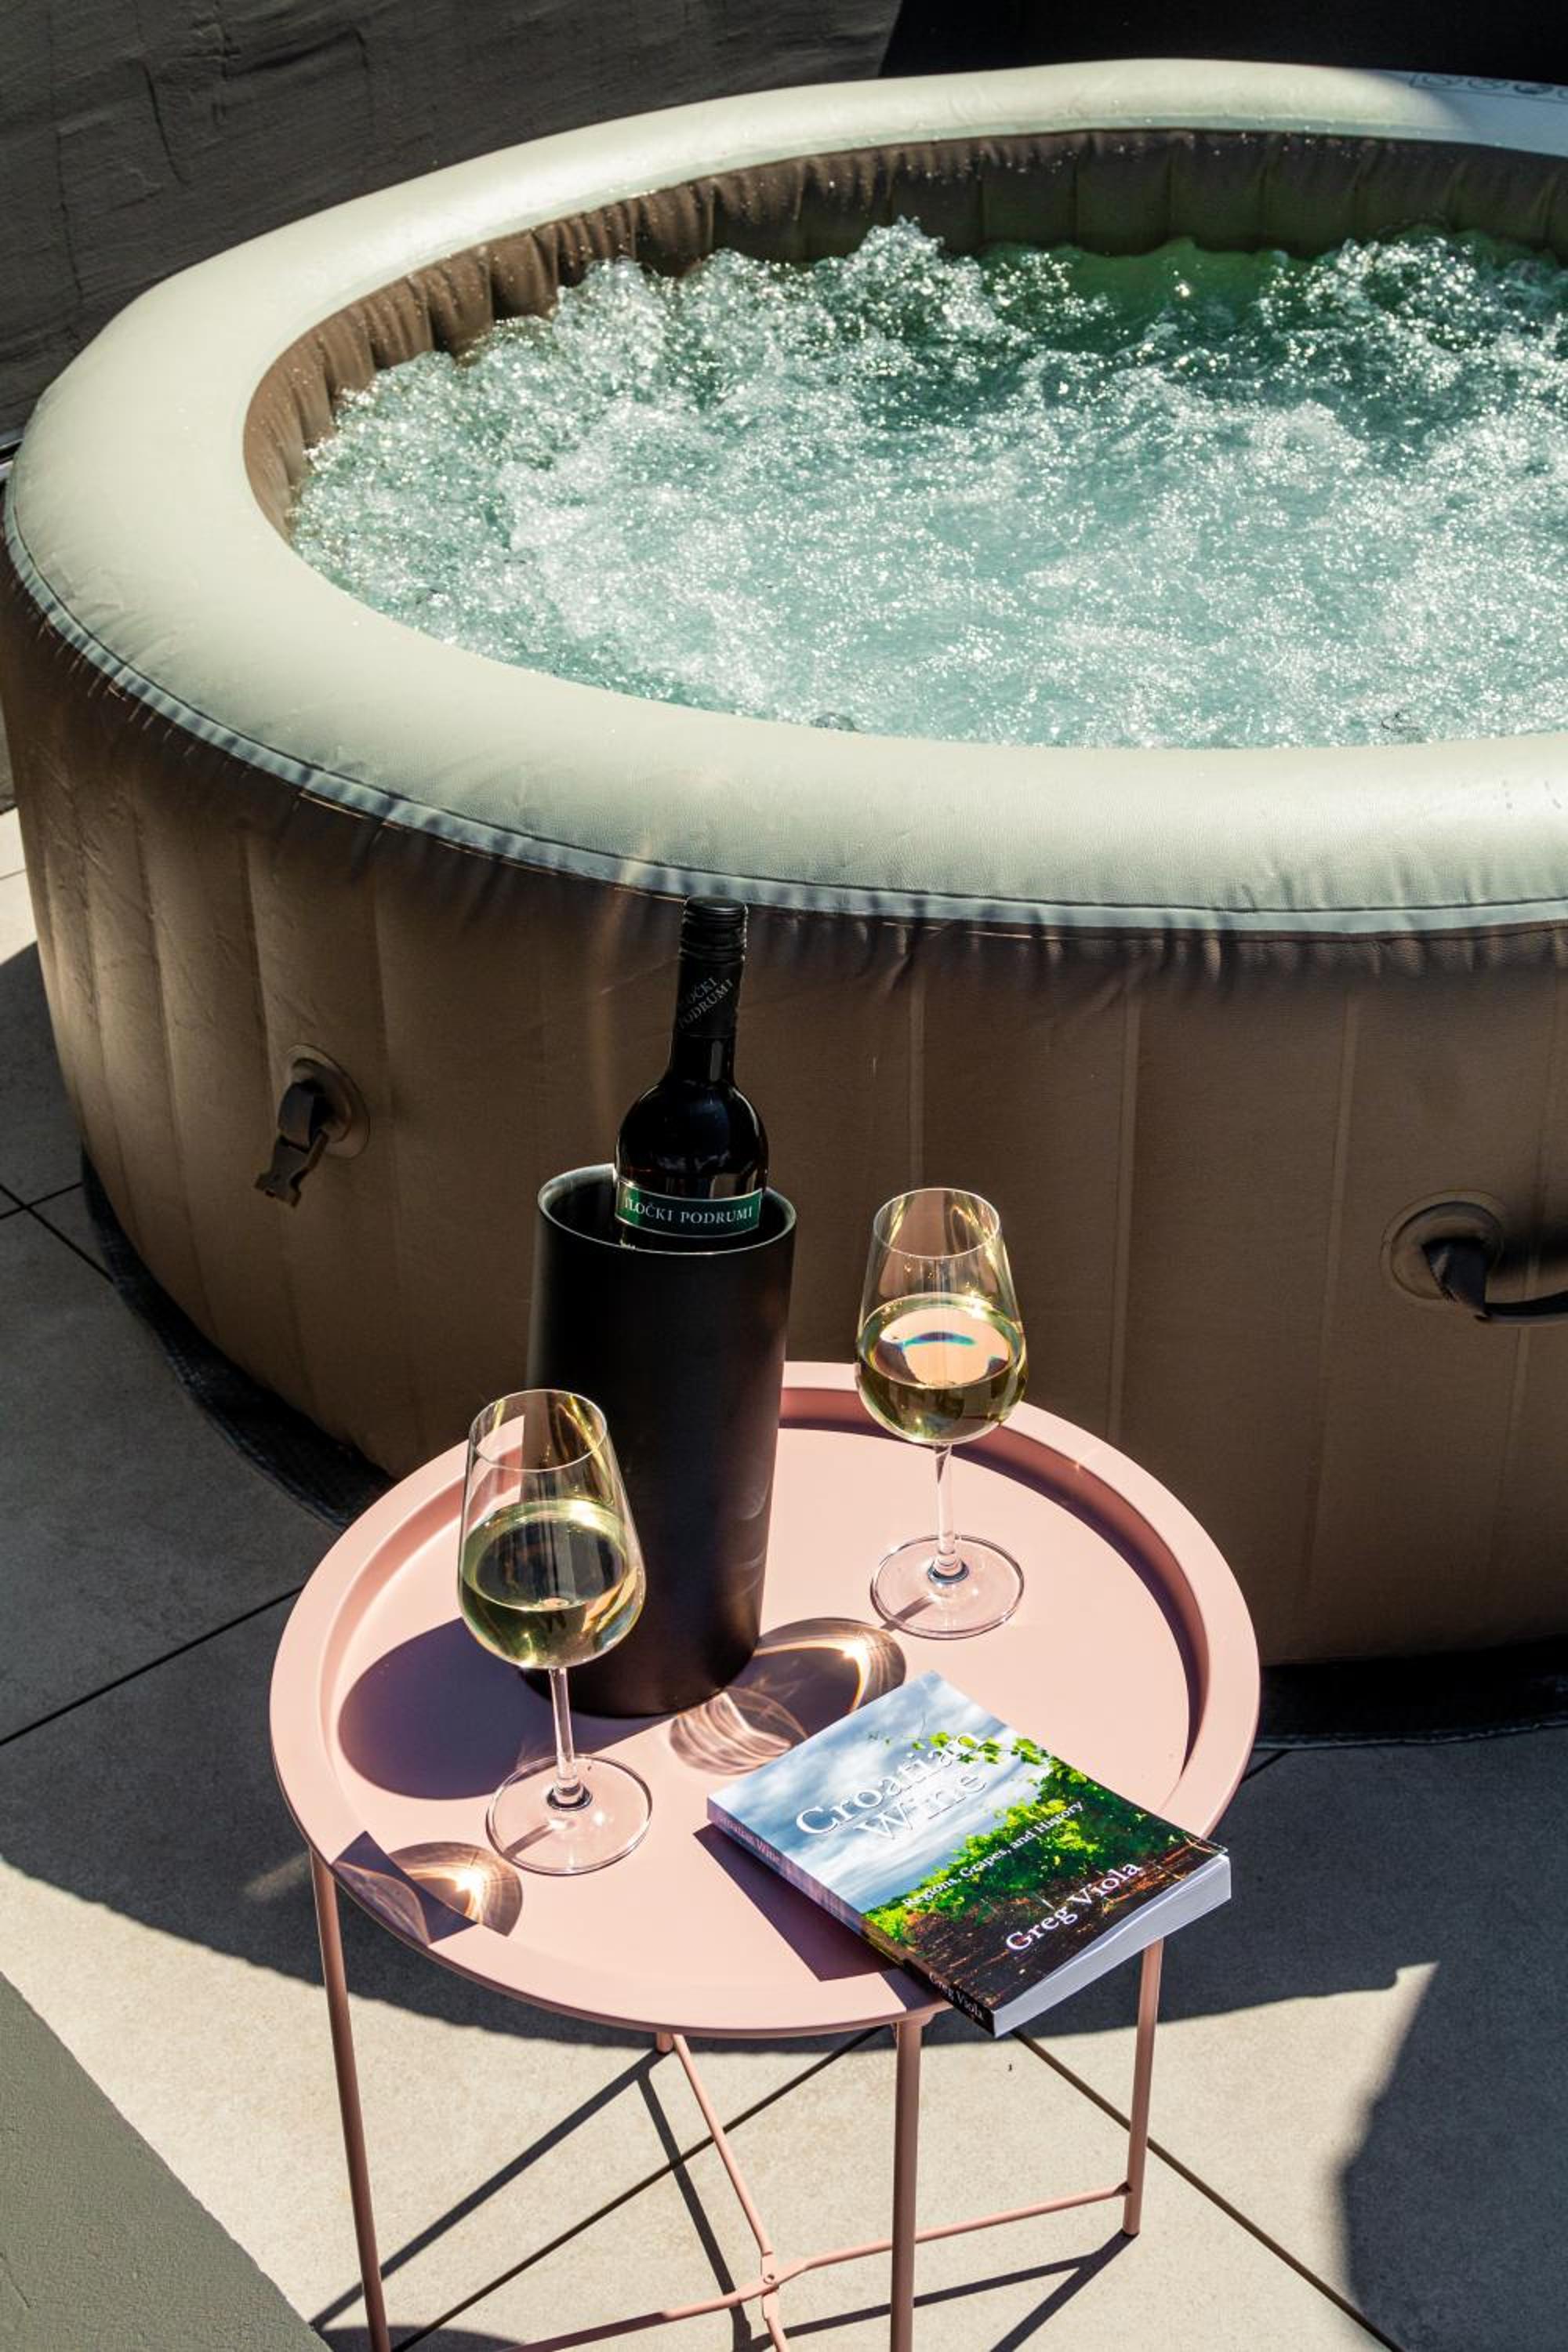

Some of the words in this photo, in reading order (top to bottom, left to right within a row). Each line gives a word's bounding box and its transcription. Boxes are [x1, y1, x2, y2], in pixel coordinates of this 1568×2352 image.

[680, 1205, 753, 1224] PODRUMI
[795, 1732, 985, 1835] Croatian
[852, 1774, 986, 1840] Wine
[902, 1875, 962, 1908] Regions,
[959, 1847, 1012, 1878] Grapes,
[1010, 1828, 1036, 1849] and
[1033, 1801, 1084, 1834] History
[1006, 1906, 1078, 1951] Greg
[1066, 1864, 1143, 1905] Viola
[956, 1989, 985, 2021] Viola
